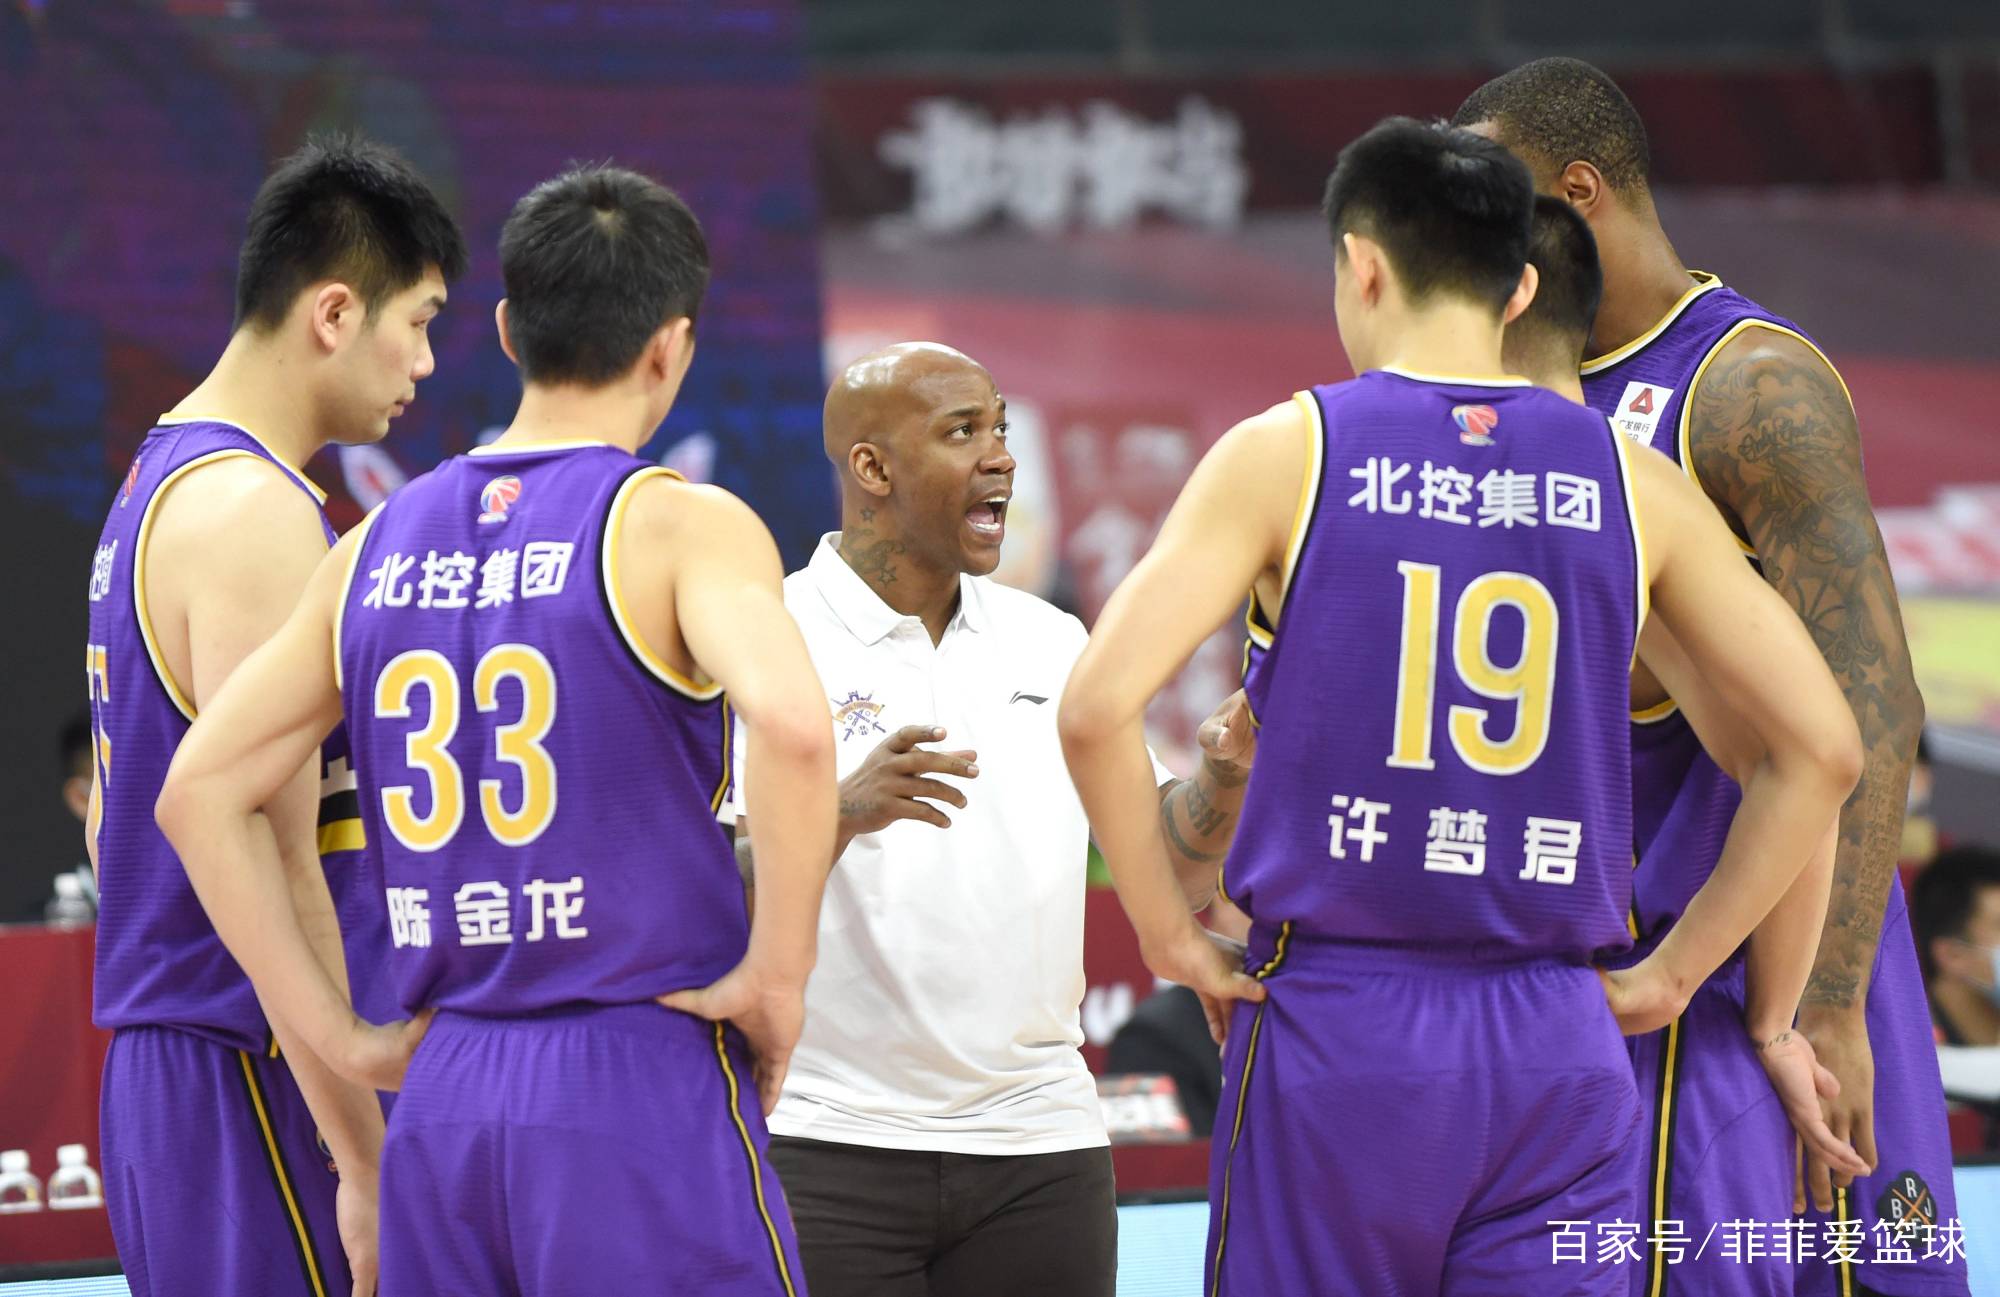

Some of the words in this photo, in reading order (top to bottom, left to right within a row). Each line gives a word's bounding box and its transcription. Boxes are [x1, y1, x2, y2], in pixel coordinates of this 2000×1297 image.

[1347, 456, 1602, 532] 北控集团
[363, 540, 575, 610] 北控集团
[1386, 560, 1559, 776] 19
[374, 643, 558, 853] 33
